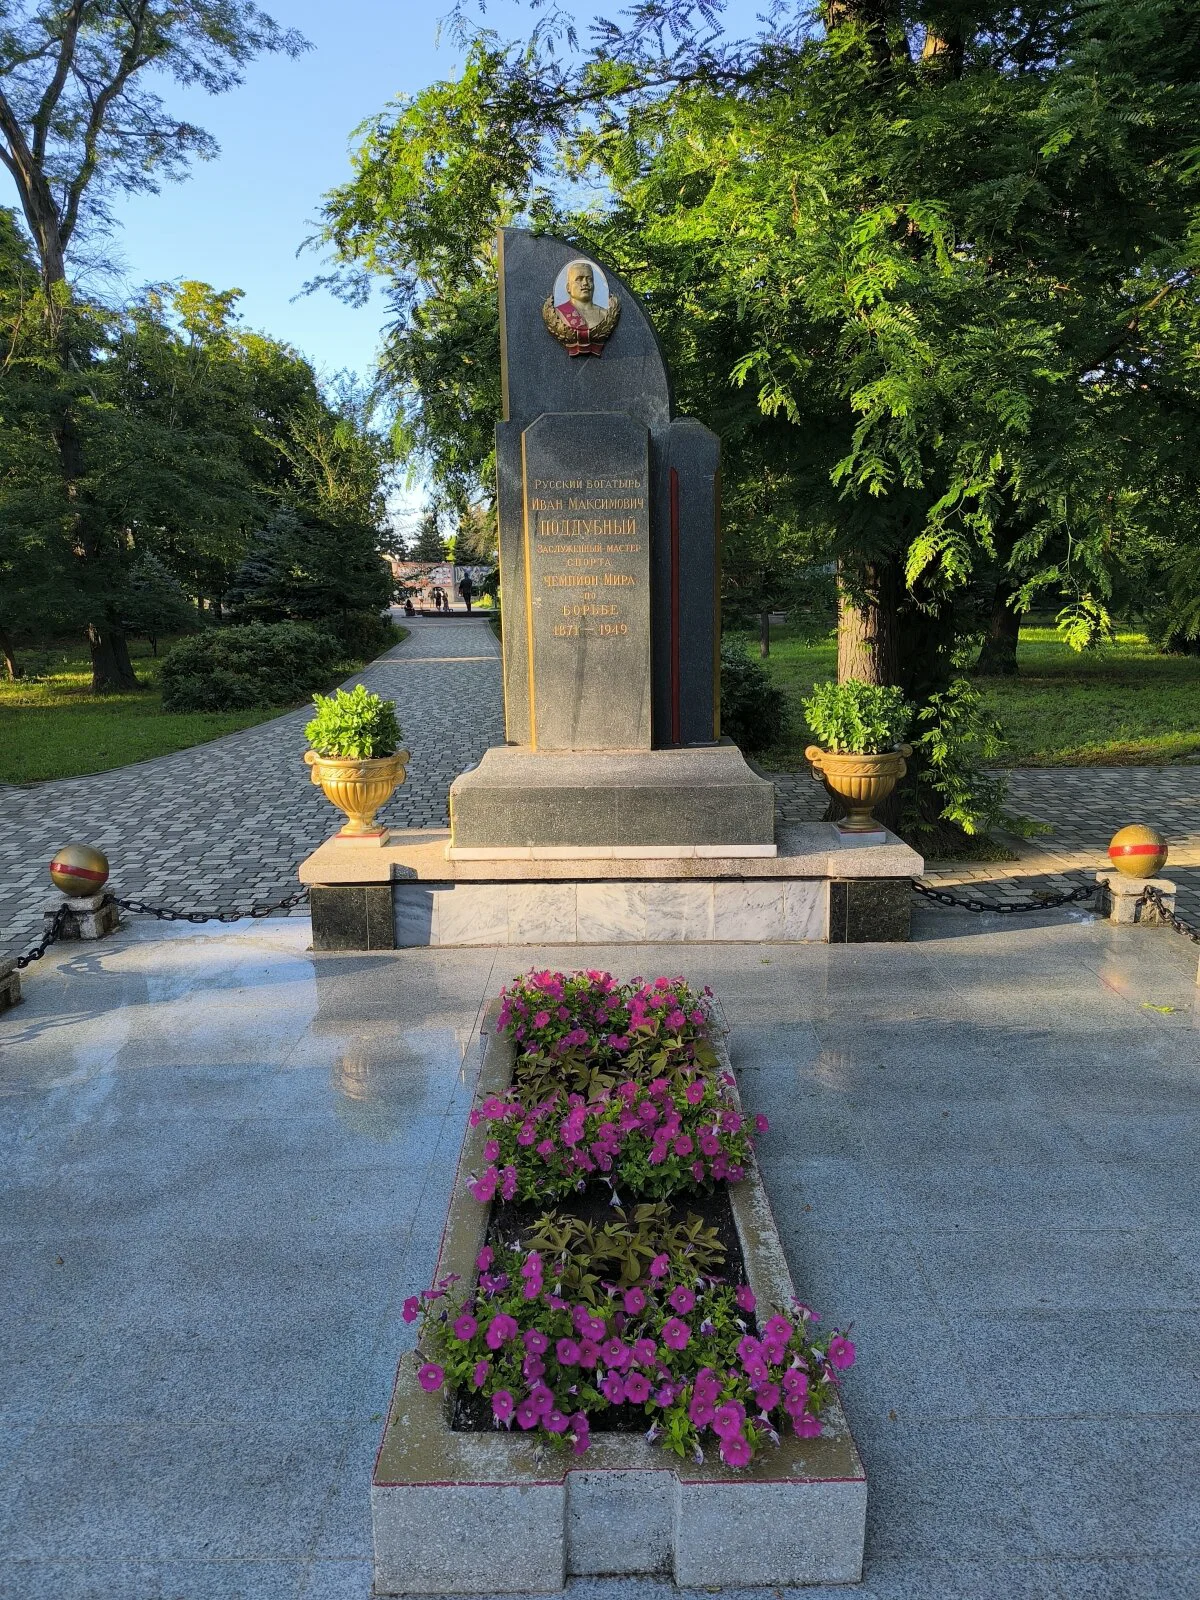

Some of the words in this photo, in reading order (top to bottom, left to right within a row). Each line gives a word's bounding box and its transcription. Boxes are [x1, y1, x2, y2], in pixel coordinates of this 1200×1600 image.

[586, 479, 641, 489] БОГАТЫРЬ
[541, 516, 637, 537] ПОДДУБНЫЙ
[606, 544, 641, 553] МАСТЕР
[566, 559, 612, 568] СПОРТА
[544, 576, 599, 588] ЧЕМПИОН
[563, 605, 619, 617] БОРЬБЕ
[553, 626, 578, 636] 1871
[599, 624, 628, 636] 1949
